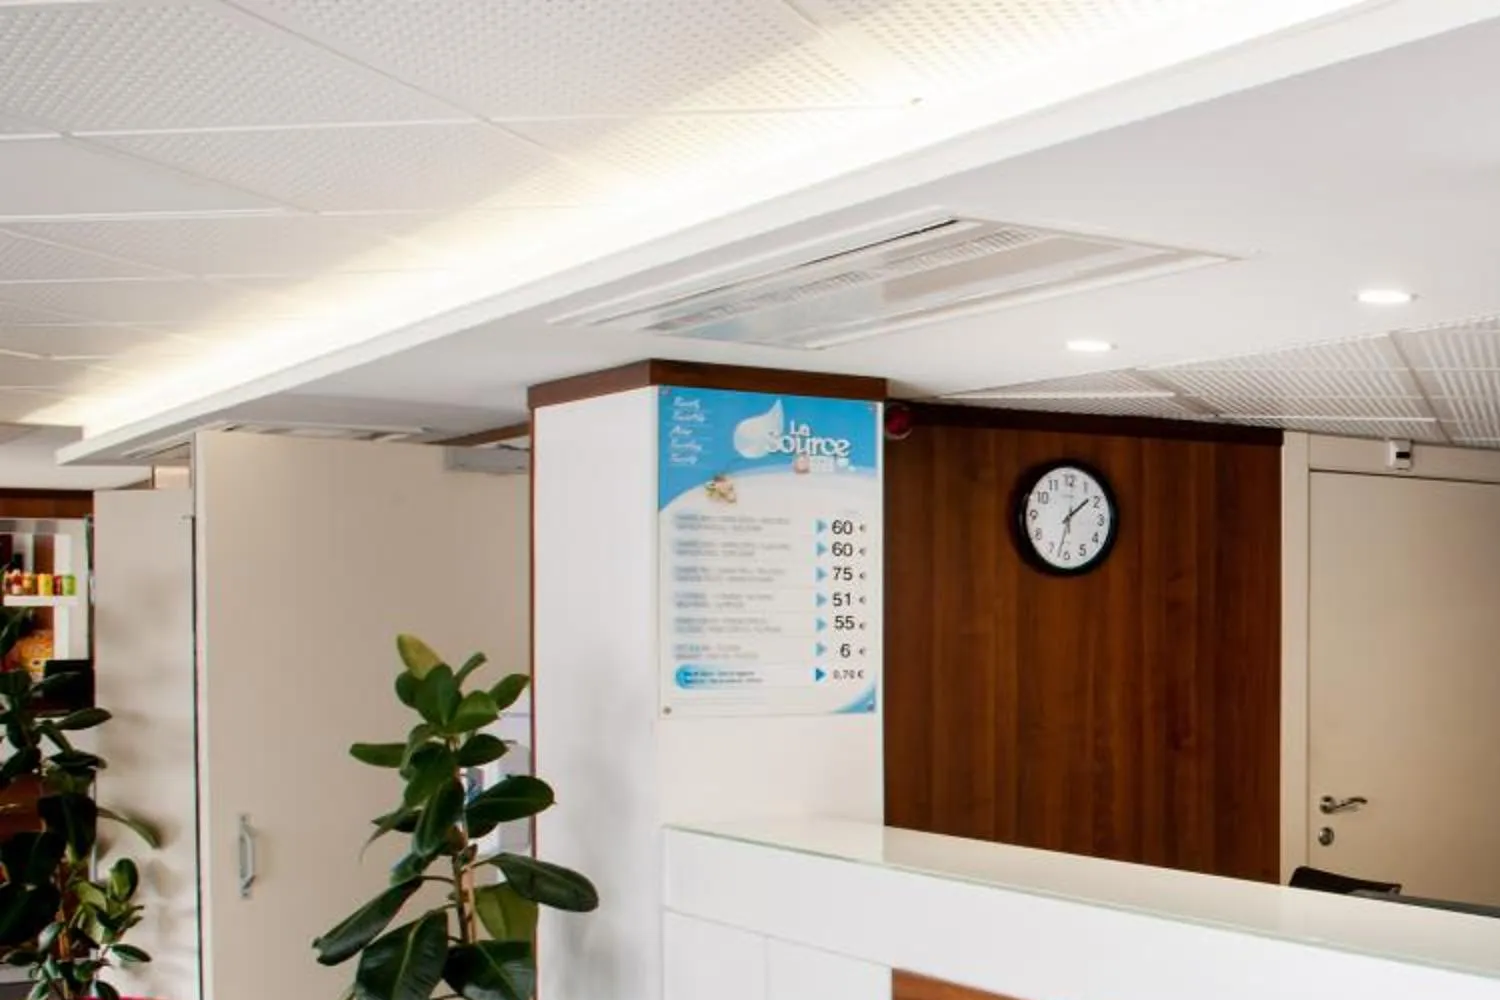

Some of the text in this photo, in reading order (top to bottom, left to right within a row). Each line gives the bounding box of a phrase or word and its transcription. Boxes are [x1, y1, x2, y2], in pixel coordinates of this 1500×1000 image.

[789, 419, 811, 437] La
[767, 431, 851, 458] Source
[1037, 491, 1049, 505] 10
[1093, 495, 1101, 509] 2
[831, 519, 853, 535] 60
[1097, 514, 1105, 527] 3
[1092, 531, 1099, 543] 4
[831, 541, 853, 557] 60
[1079, 543, 1087, 557] 5
[833, 565, 853, 581] 75
[832, 591, 851, 607] 51
[834, 615, 855, 630] 55
[840, 643, 851, 658] 6
